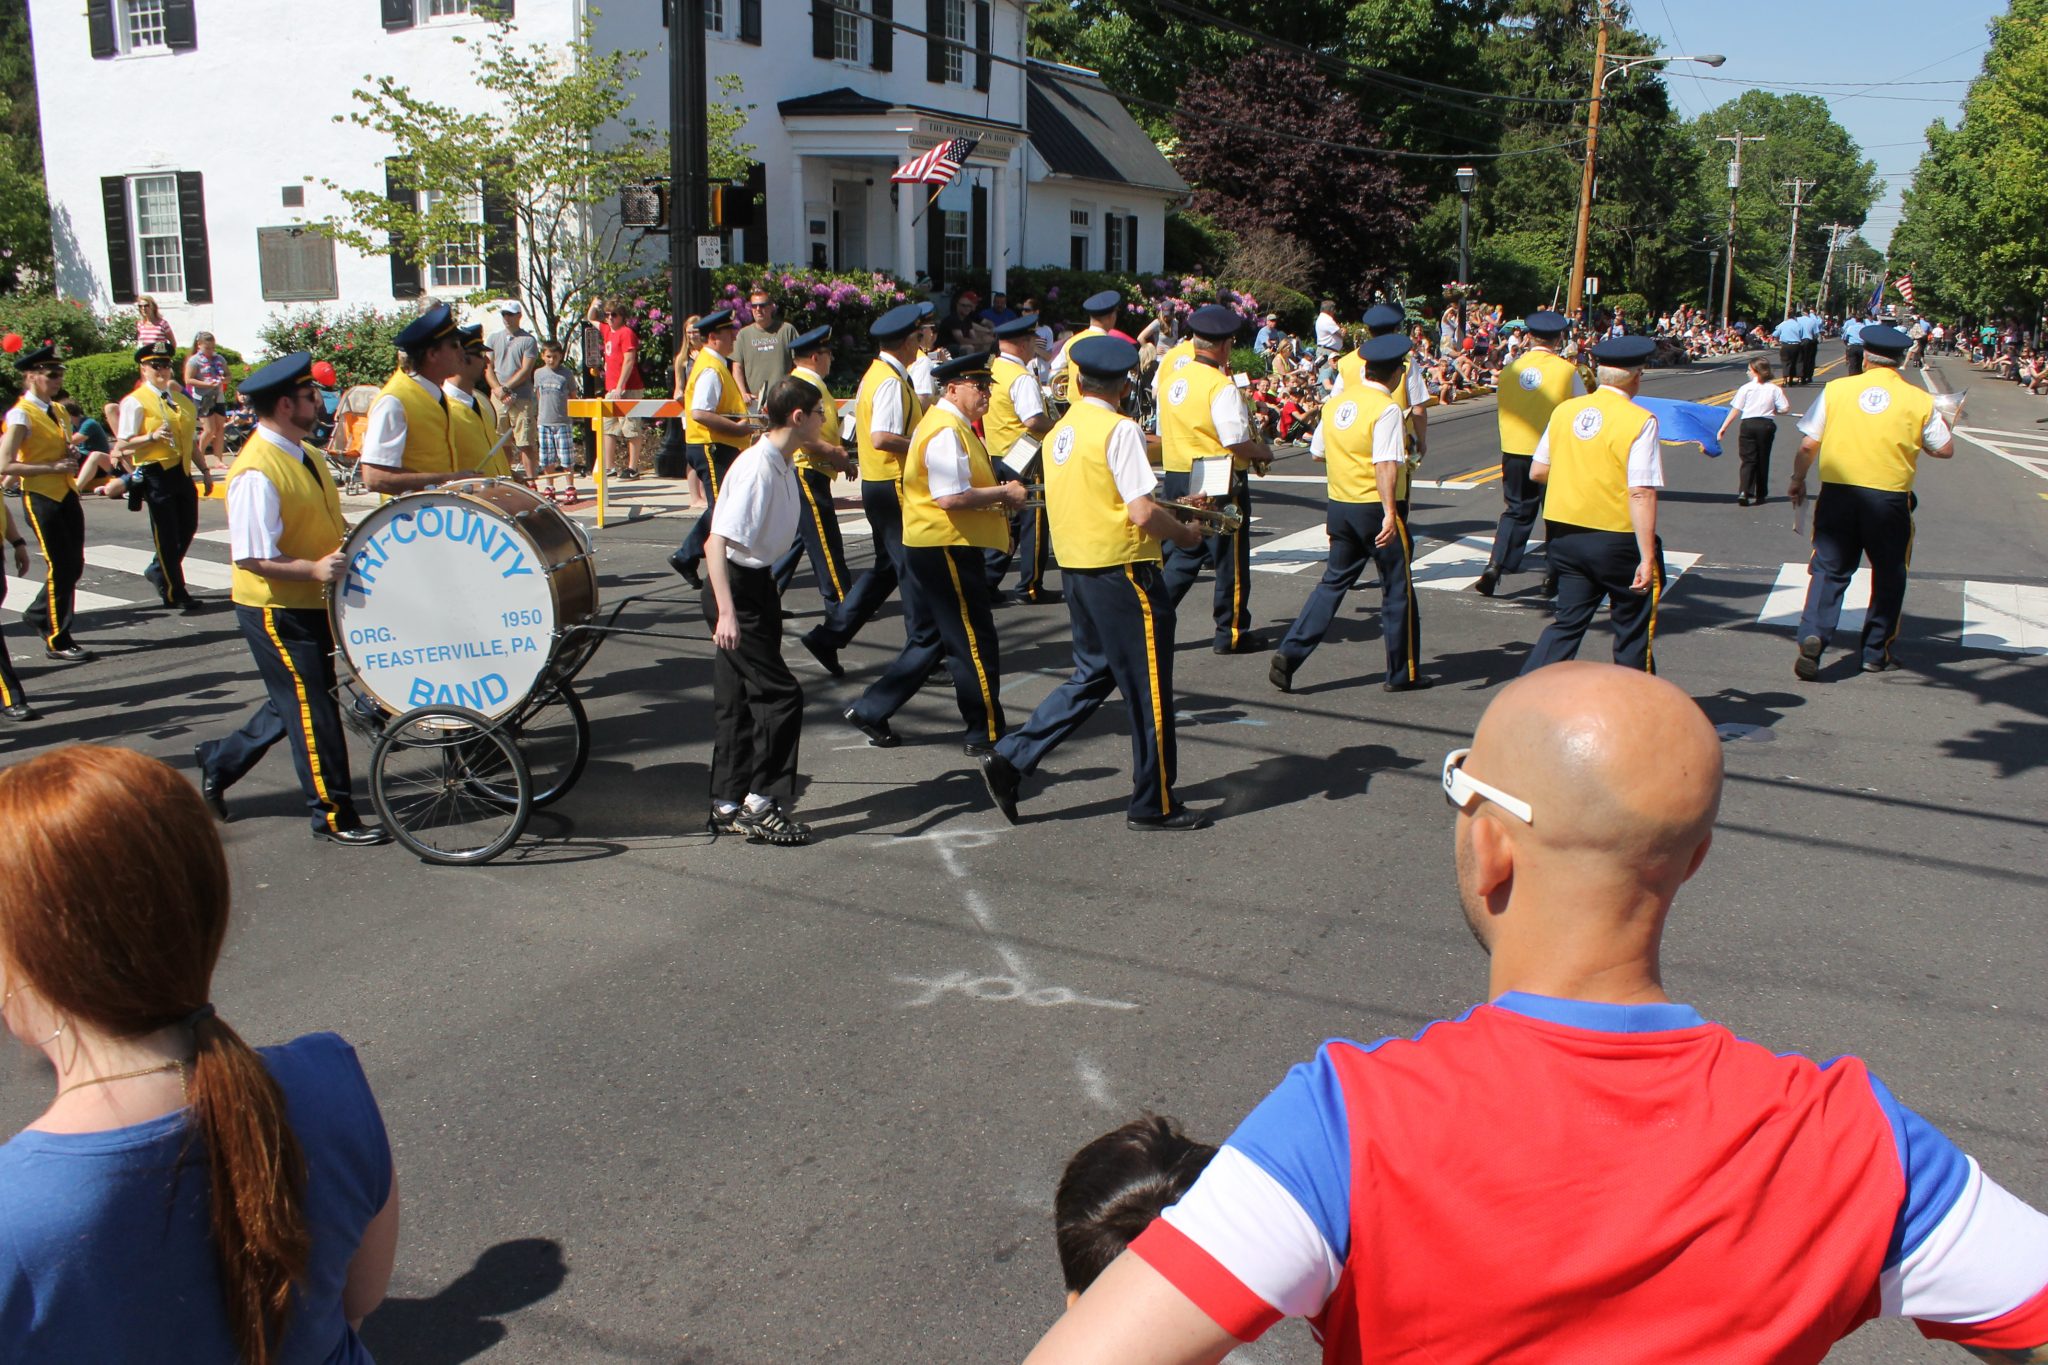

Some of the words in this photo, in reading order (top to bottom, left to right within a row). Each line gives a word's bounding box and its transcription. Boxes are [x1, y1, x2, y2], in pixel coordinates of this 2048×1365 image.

[929, 123, 943, 133] THE
[994, 134, 1016, 144] HOUSE
[700, 237, 708, 246] SR
[342, 506, 534, 597] TRI-COUNTY
[350, 626, 397, 646] ORG.
[501, 608, 543, 628] 1950
[365, 639, 510, 670] FEASTERVILLE,
[512, 636, 538, 654] PA
[408, 672, 509, 710] BAND
